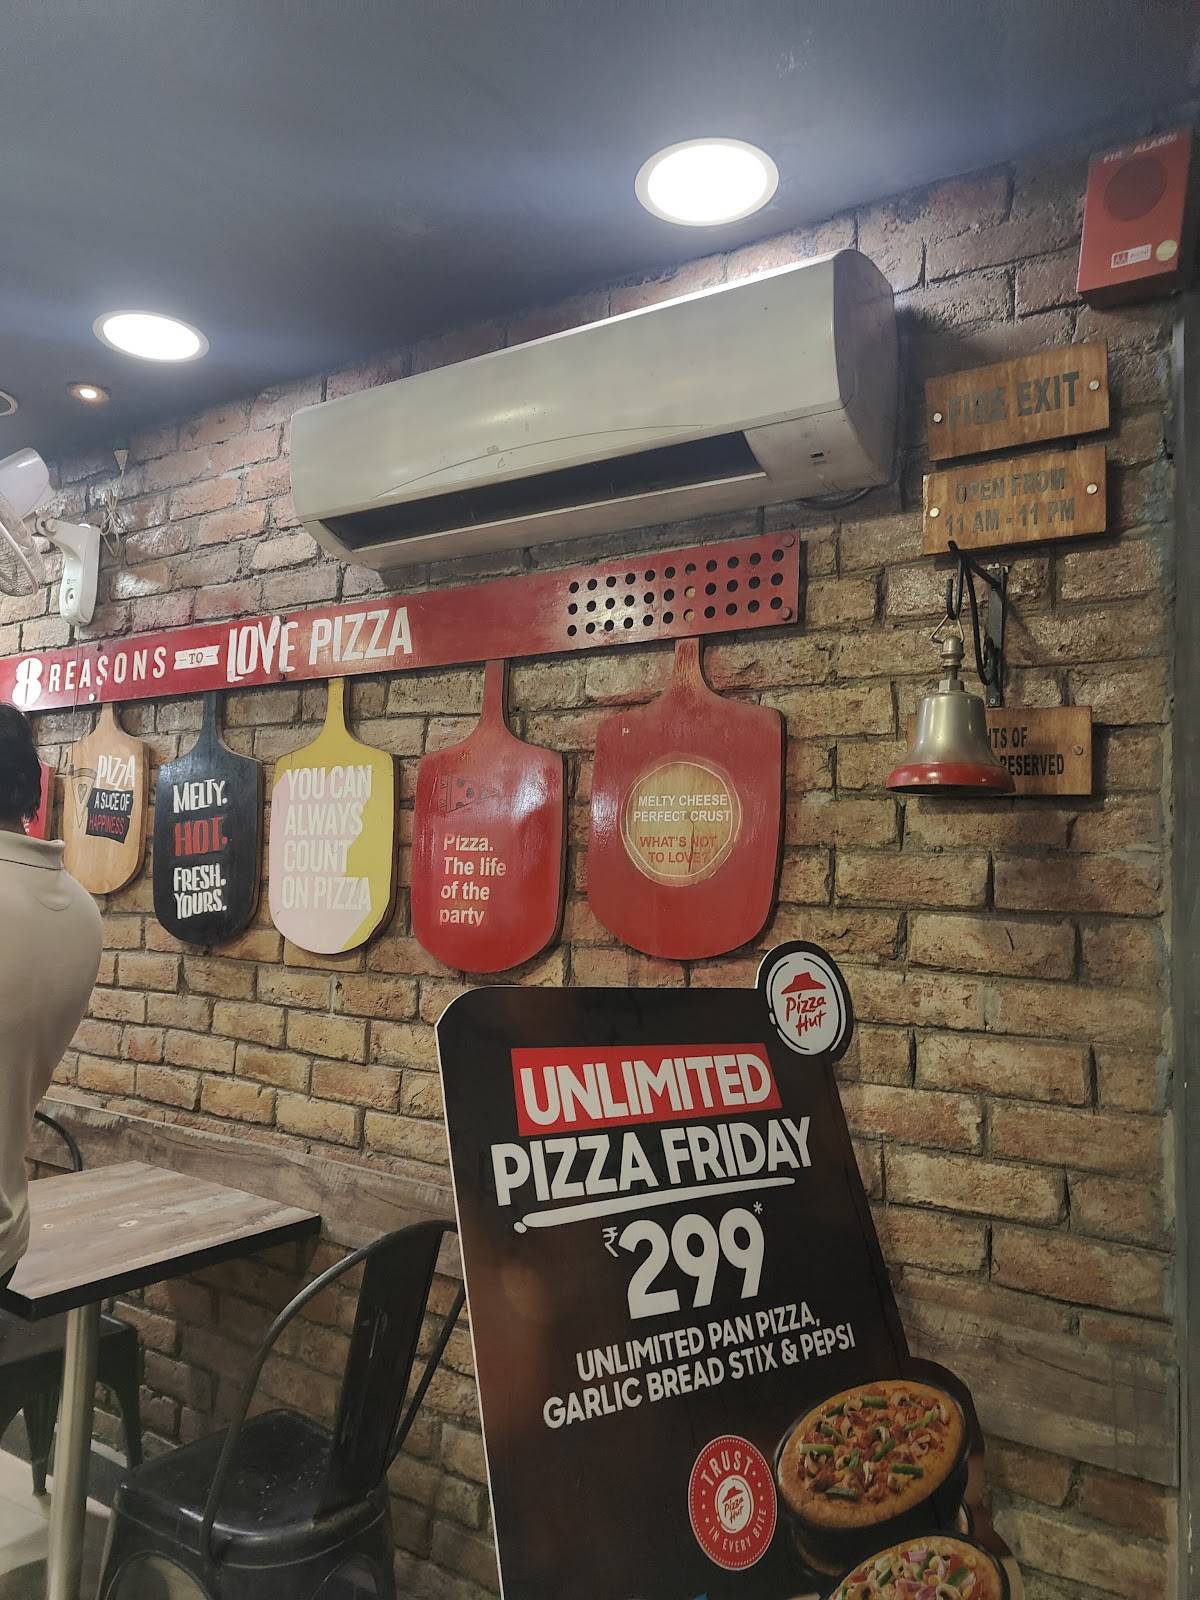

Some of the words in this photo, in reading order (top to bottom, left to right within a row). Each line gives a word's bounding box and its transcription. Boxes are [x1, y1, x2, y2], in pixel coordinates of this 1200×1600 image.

[1017, 371, 1079, 416] EXIT
[955, 479, 1005, 504] OPEN
[1011, 468, 1066, 497] FROM
[946, 512, 964, 537] 11
[973, 508, 999, 533] AM
[1019, 502, 1038, 527] 11
[1048, 498, 1075, 524] PM
[12, 657, 43, 707] 8
[48, 646, 167, 692] REASONS
[227, 615, 299, 683] LOVE
[309, 606, 413, 665] PIZZA
[1012, 726, 1028, 748] OF
[95, 755, 136, 791] PIZZA
[286, 767, 326, 800] YOU
[329, 765, 372, 800] CAN
[94, 793, 100, 808] A
[100, 791, 119, 811] SLICE
[120, 793, 130, 811] OF
[173, 779, 228, 813] MELTY.
[638, 795, 676, 807] MELTY
[679, 794, 728, 806] CHEESE
[89, 815, 125, 835] HAPPINESS
[284, 801, 363, 836] ALWAYS
[633, 811, 687, 822] PERFECT
[690, 810, 731, 822] CRUST
[174, 816, 229, 856] HOT.
[444, 833, 494, 852] Pizza.
[640, 836, 687, 848] WHAT'S
[690, 835, 717, 848] NOT
[283, 839, 350, 873] COUNT
[444, 857, 474, 876] The
[479, 857, 507, 876] life
[648, 852, 665, 863] TO
[173, 863, 227, 892] FRESH.
[282, 876, 307, 910] ON
[313, 876, 372, 911] PIZZA
[441, 880, 459, 899] of
[462, 881, 490, 901] the
[174, 889, 228, 920] YOURS.
[440, 906, 485, 927] party
[786, 993, 827, 1023] Pizza
[796, 1009, 827, 1037] Hut
[520, 1053, 772, 1126] UNLIMITED
[491, 1131, 659, 1206] PIZZA
[660, 1116, 812, 1185] FRIDAY
[576, 1326, 704, 1381] UNLIMITED
[708, 1314, 754, 1350] PAN
[755, 1301, 820, 1337] PIZZA,
[543, 1377, 643, 1428] GARLIC
[646, 1357, 725, 1402] BREAD
[729, 1343, 778, 1379] STIX
[781, 1338, 799, 1365] &
[800, 1323, 855, 1361] PEPSI
[701, 1450, 753, 1487] TRUST
[724, 1497, 744, 1517] Pizza
[730, 1506, 744, 1524] Hut
[709, 1527, 720, 1542] IN
[722, 1535, 752, 1553] EVERY
[753, 1508, 767, 1538] BITE
